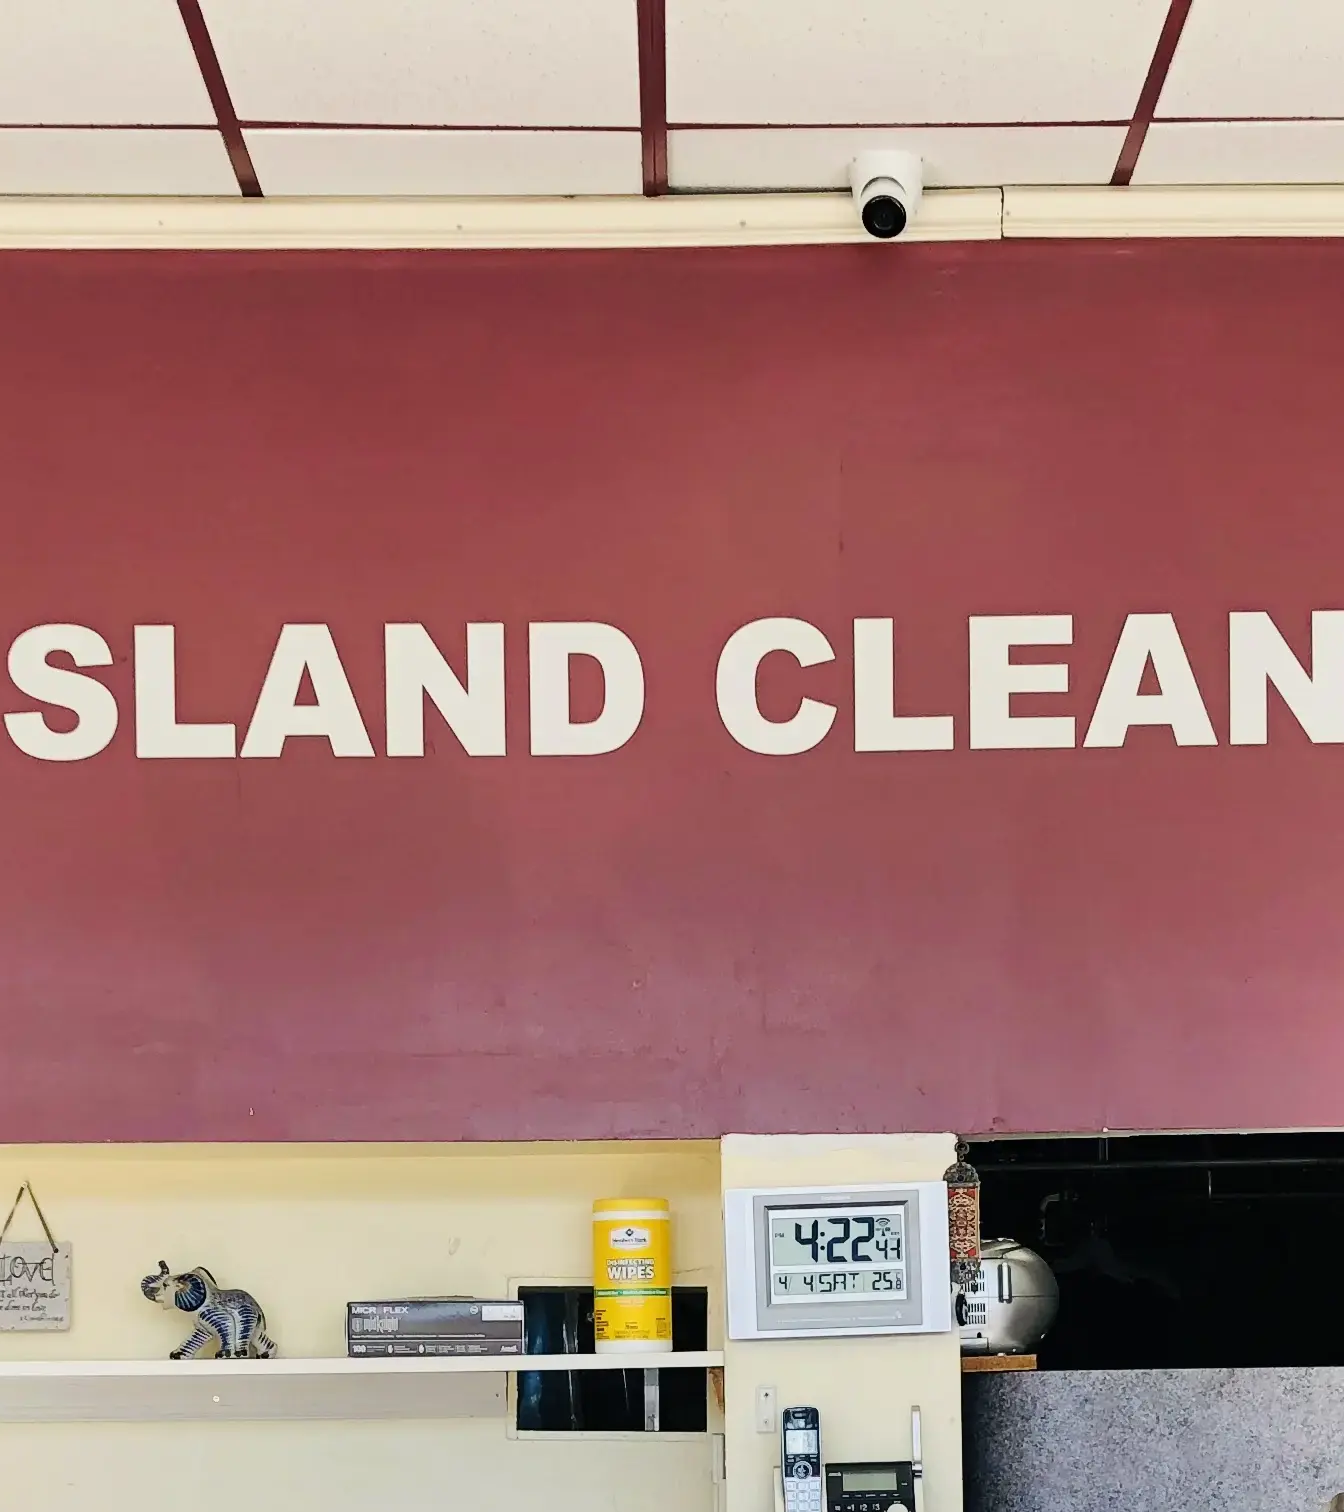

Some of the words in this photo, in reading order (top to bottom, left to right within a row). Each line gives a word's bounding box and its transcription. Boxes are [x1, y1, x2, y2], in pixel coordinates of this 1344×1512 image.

[795, 1217, 875, 1263] 4:22
[607, 1266, 655, 1280] WIPES
[819, 1273, 860, 1293] SAT
